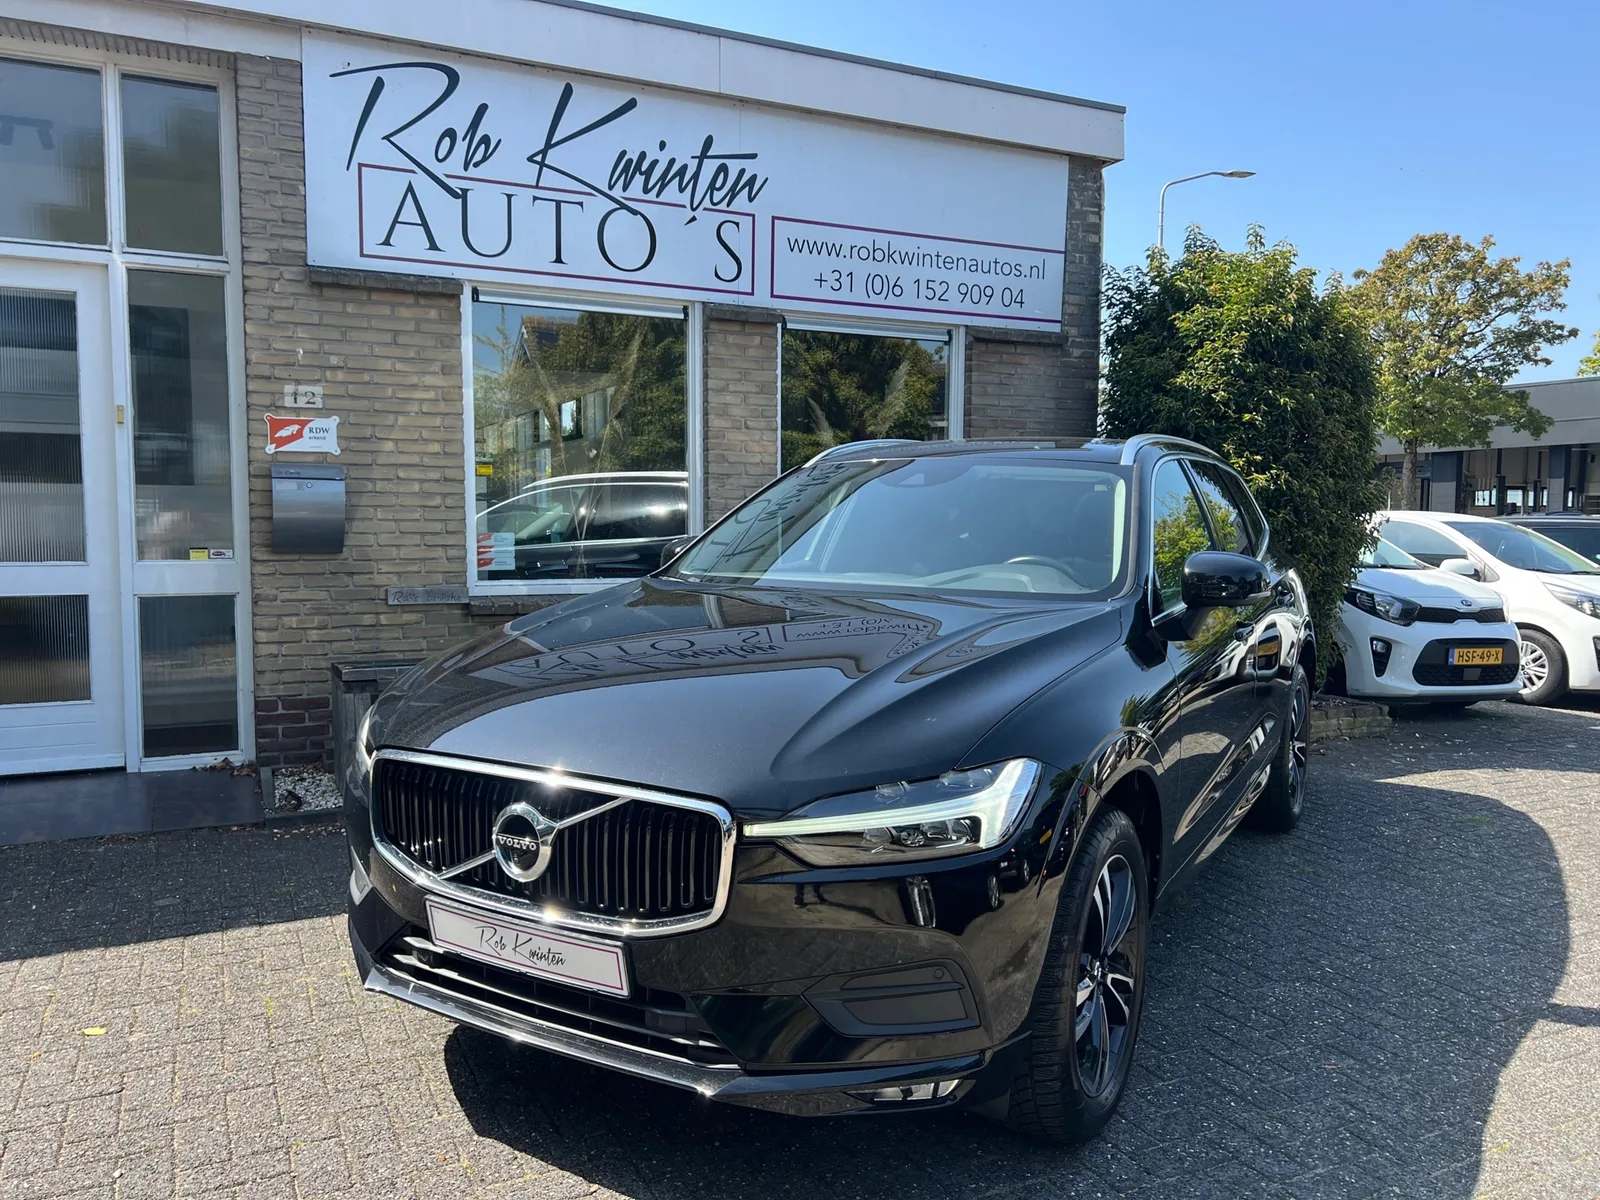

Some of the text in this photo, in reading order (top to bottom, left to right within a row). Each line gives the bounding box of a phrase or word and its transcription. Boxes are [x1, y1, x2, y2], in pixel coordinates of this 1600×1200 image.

[329, 61, 769, 215] Rob Kwinten
[786, 237, 1046, 281] www.robkwintenautos.nl
[814, 270, 1025, 309] +31 (0)6 152 909 04
[292, 391, 316, 405] 12
[1457, 650, 1501, 663] HSF-49-X
[497, 835, 537, 851] VOLVO
[475, 926, 566, 966] Rob Kwinten
